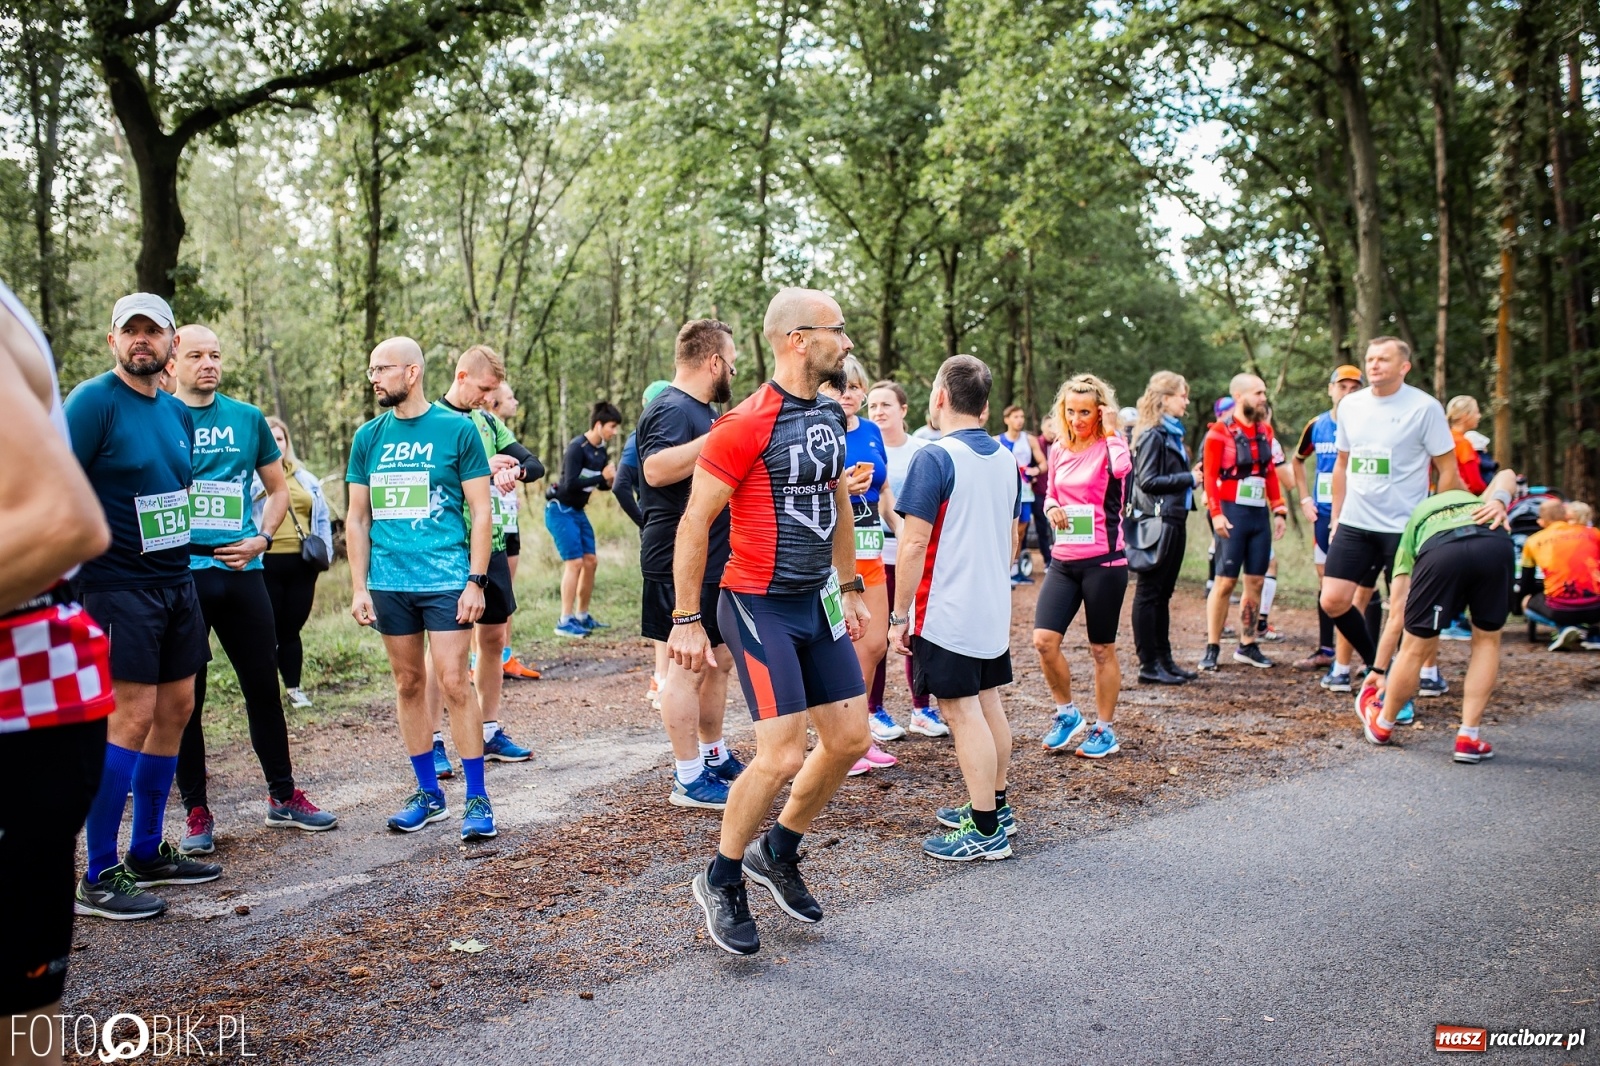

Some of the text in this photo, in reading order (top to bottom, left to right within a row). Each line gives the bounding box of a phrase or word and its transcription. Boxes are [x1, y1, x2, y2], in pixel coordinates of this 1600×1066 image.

[193, 426, 235, 447] BM
[225, 445, 240, 453] Team
[381, 442, 433, 462] ZBM
[420, 461, 436, 469] Team
[1357, 459, 1378, 474] 20
[385, 487, 411, 507] 57
[783, 485, 816, 495] CROSS
[817, 483, 823, 492] &
[1250, 487, 1263, 499] 19
[194, 496, 225, 517] 98
[153, 508, 186, 535] 134
[857, 532, 880, 549] 146
